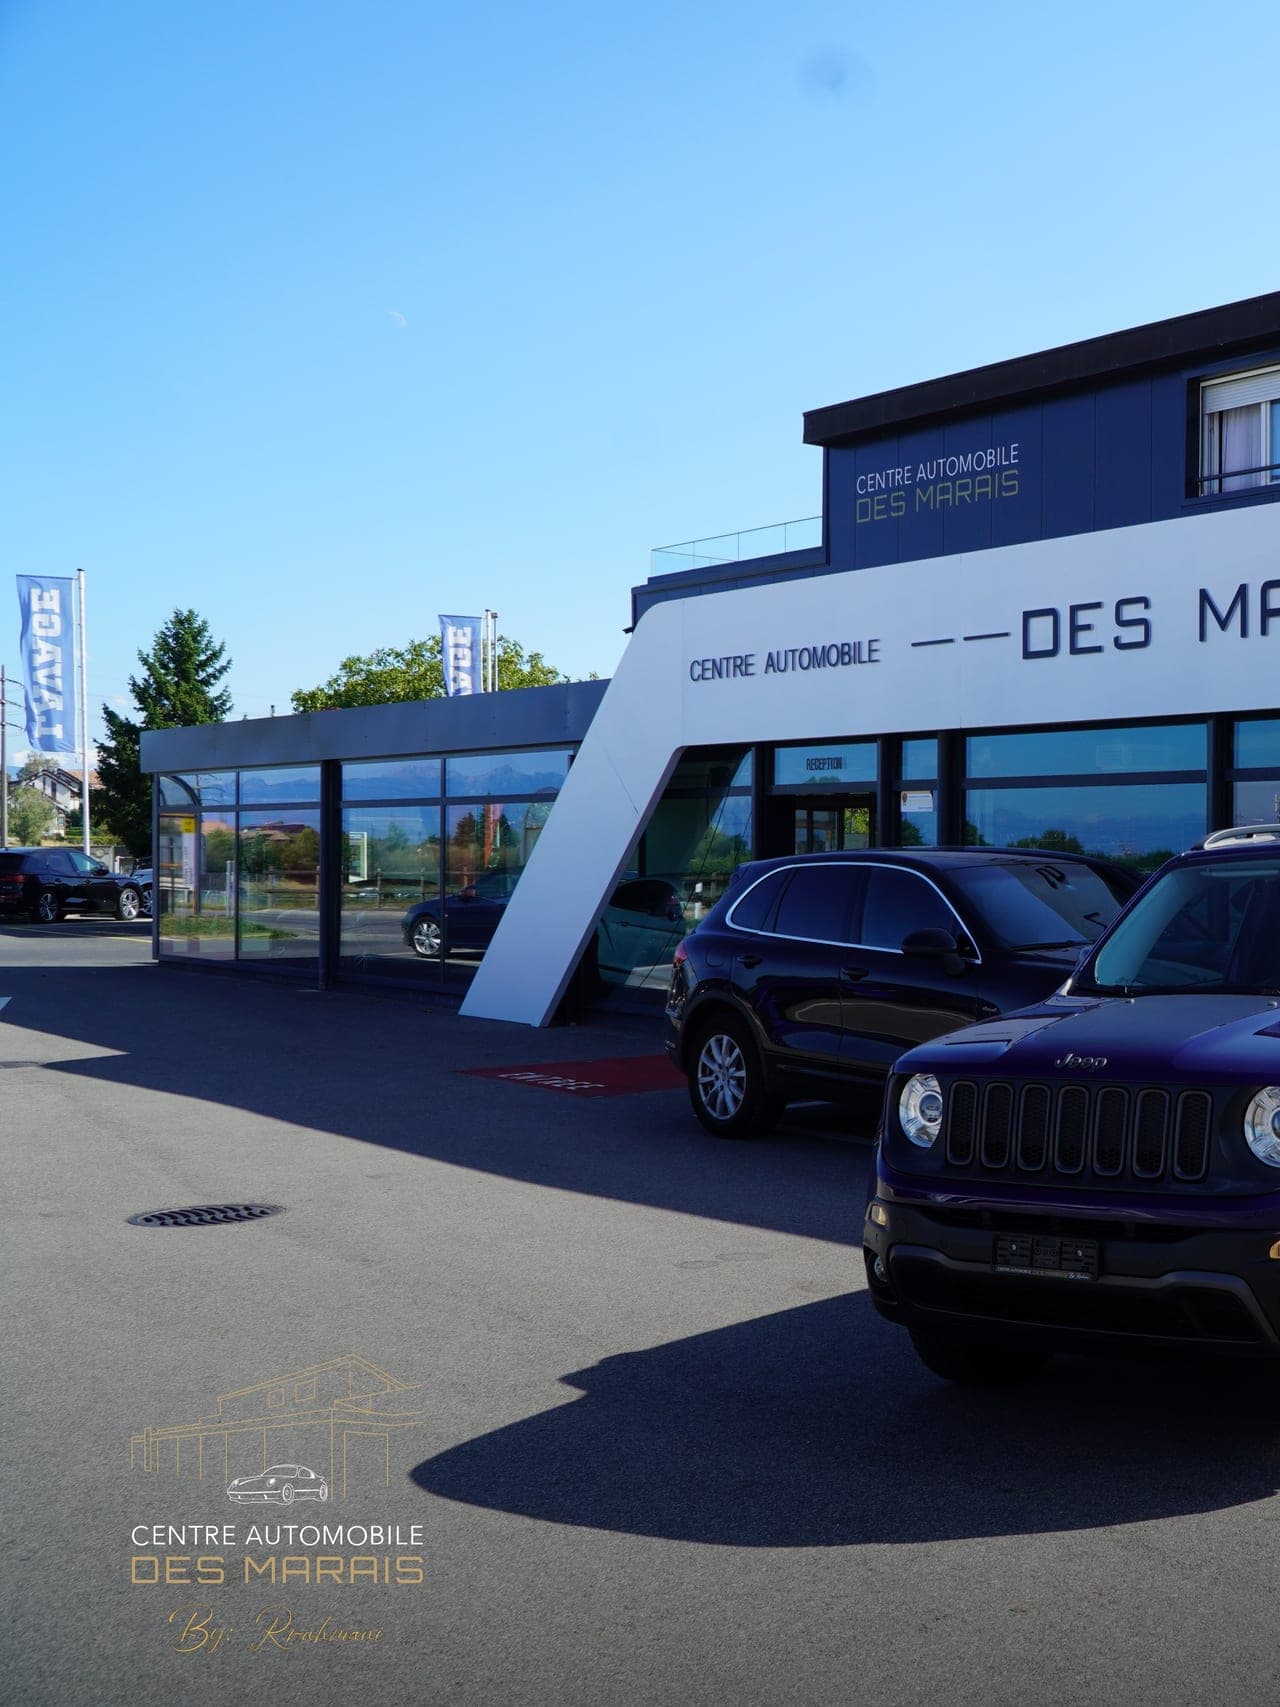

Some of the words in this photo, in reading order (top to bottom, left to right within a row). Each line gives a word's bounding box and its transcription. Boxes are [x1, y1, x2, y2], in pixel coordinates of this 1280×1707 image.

[856, 465, 912, 495] CENTRE
[915, 443, 1019, 482] AUTOMOBILE
[856, 491, 906, 523] DES
[915, 469, 1019, 513] MARAIS
[690, 653, 756, 682] CENTRE
[764, 638, 881, 674] AUTOMOBILE
[1022, 595, 1152, 660] DES
[1055, 1052, 1109, 1073] Jeep
